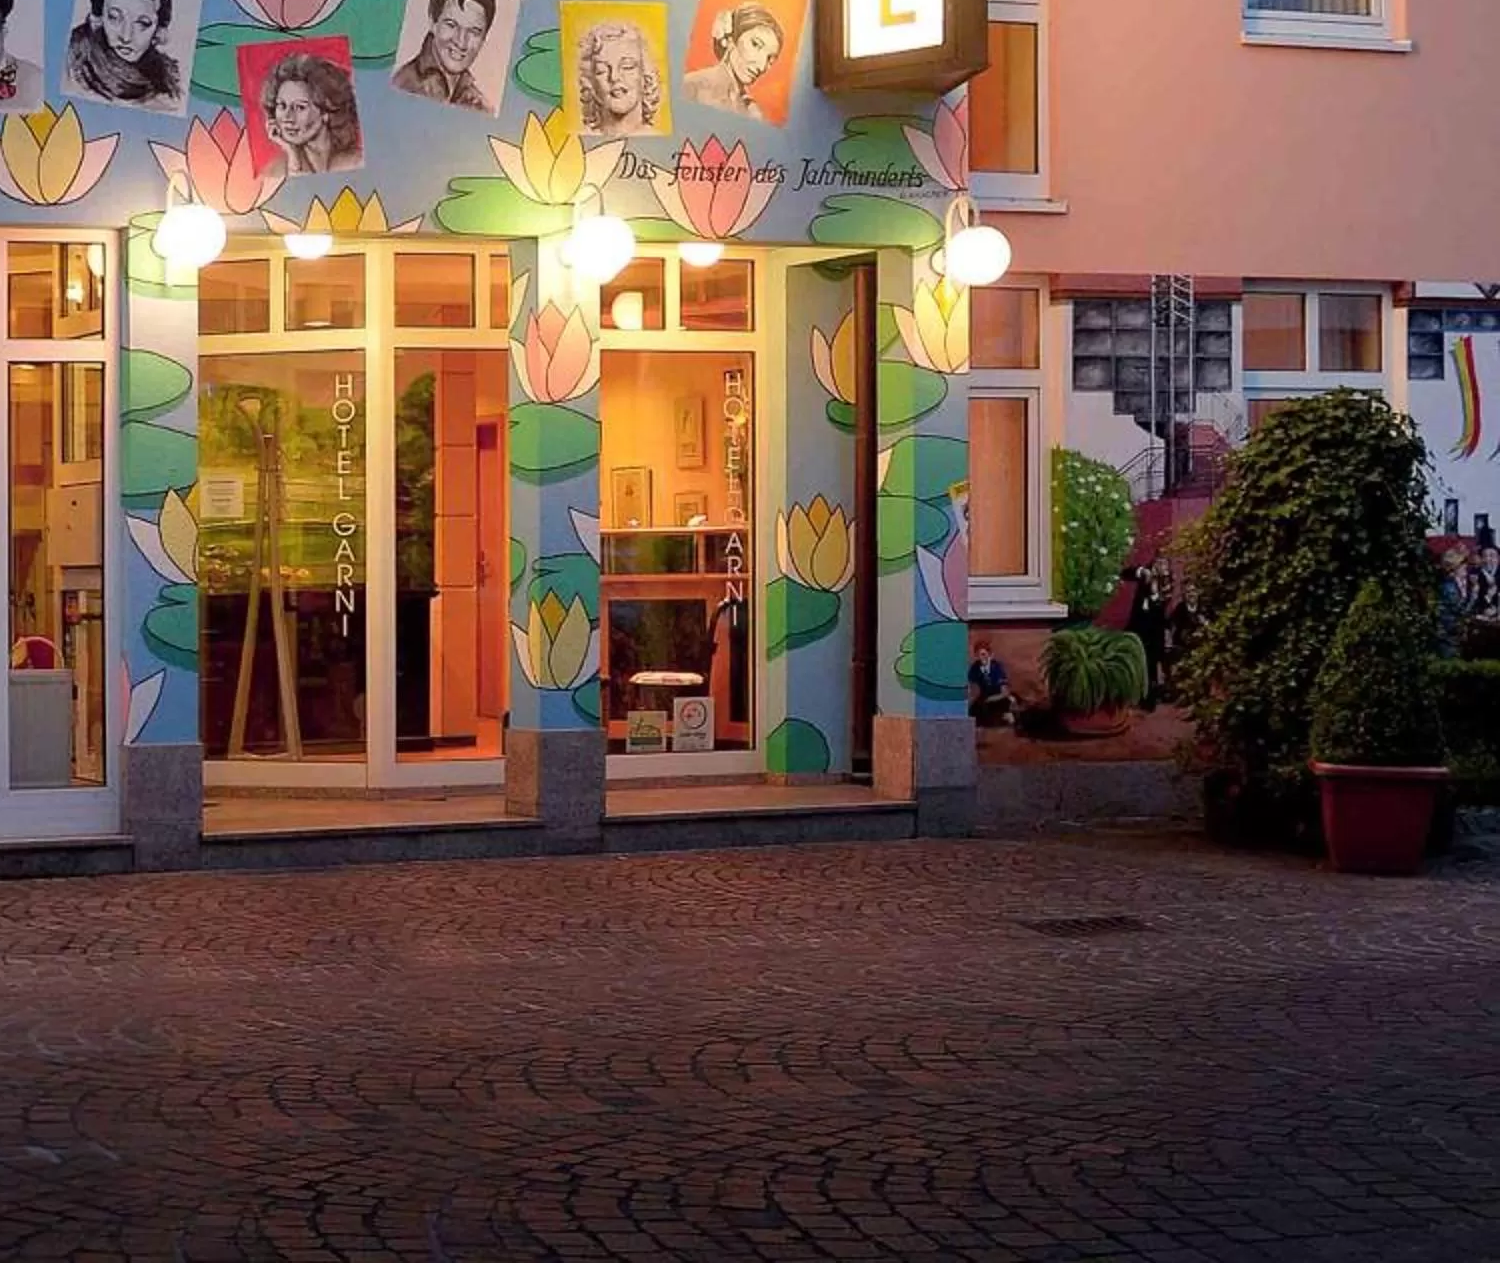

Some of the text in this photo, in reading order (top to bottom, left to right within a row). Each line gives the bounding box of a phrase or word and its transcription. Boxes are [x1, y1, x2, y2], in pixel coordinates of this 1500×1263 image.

[619, 152, 657, 180] Das
[755, 159, 788, 184] des
[792, 157, 923, 192] Jahrhunderts
[332, 373, 356, 637] HOTEL GARNI
